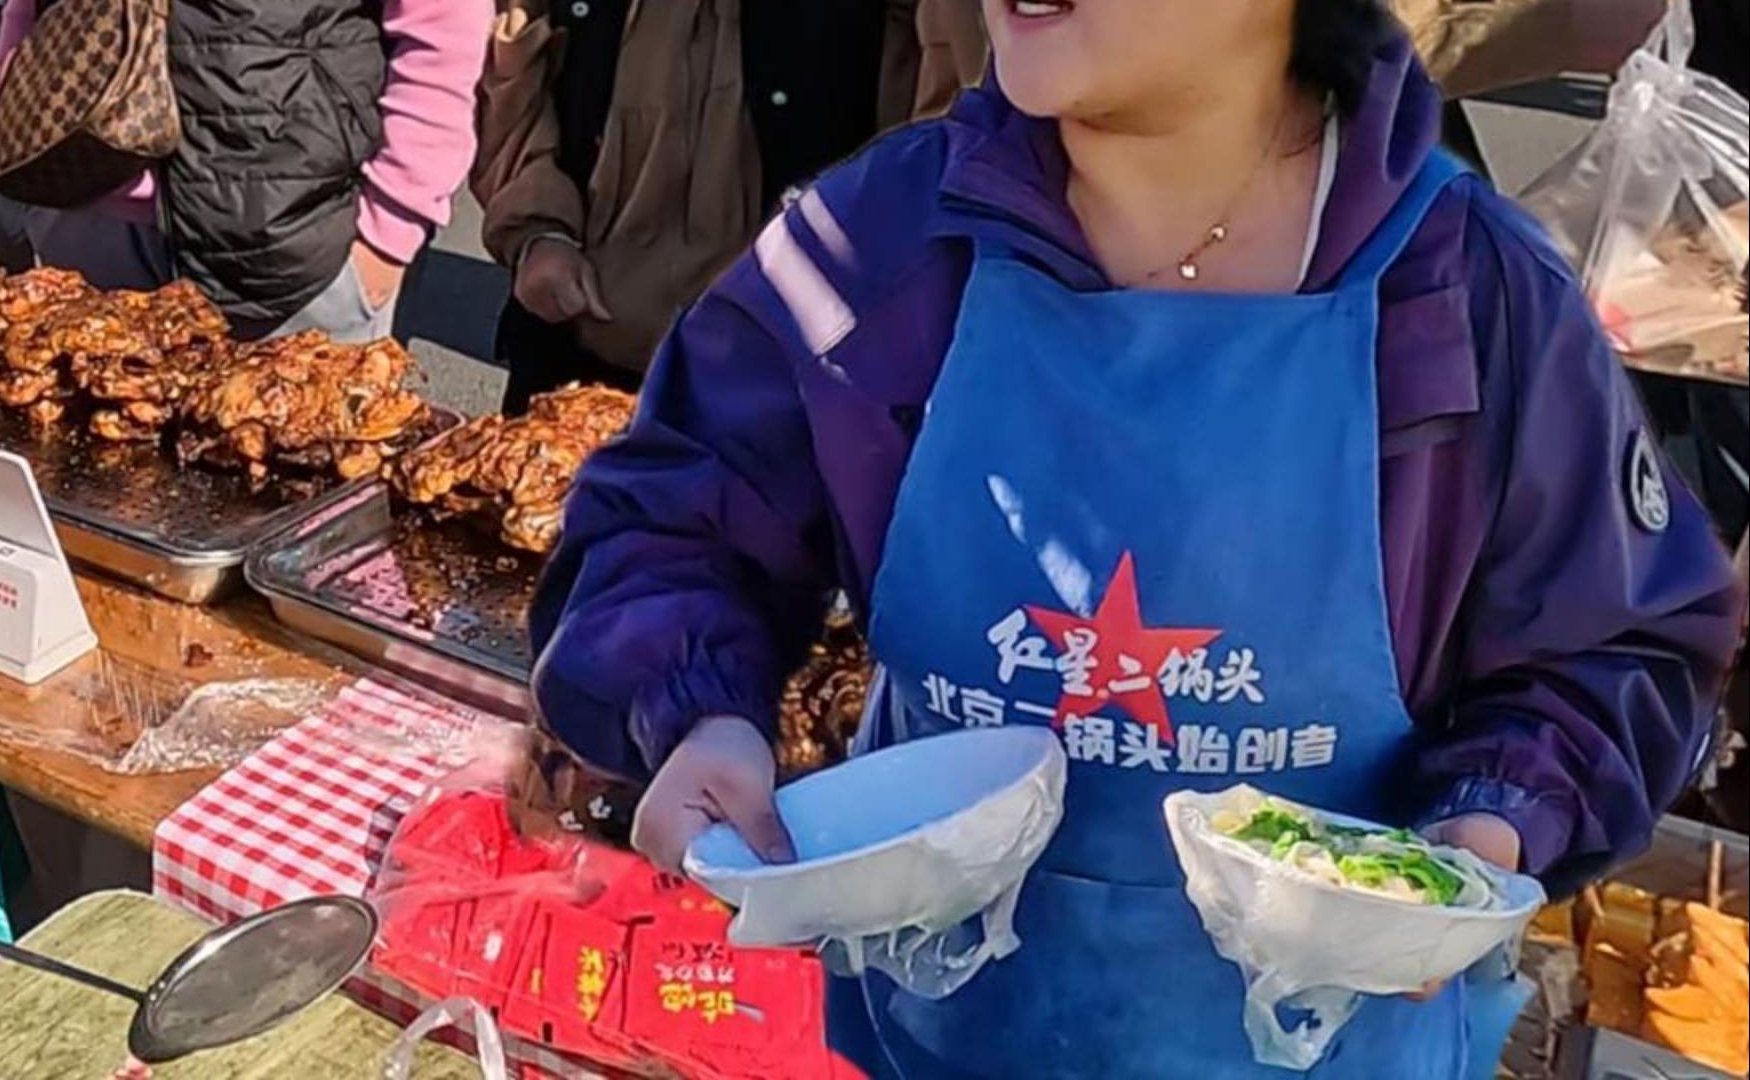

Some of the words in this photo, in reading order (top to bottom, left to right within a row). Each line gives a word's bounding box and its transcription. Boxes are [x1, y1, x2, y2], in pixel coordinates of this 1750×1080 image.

[988, 609, 1265, 703] 红星二锅头
